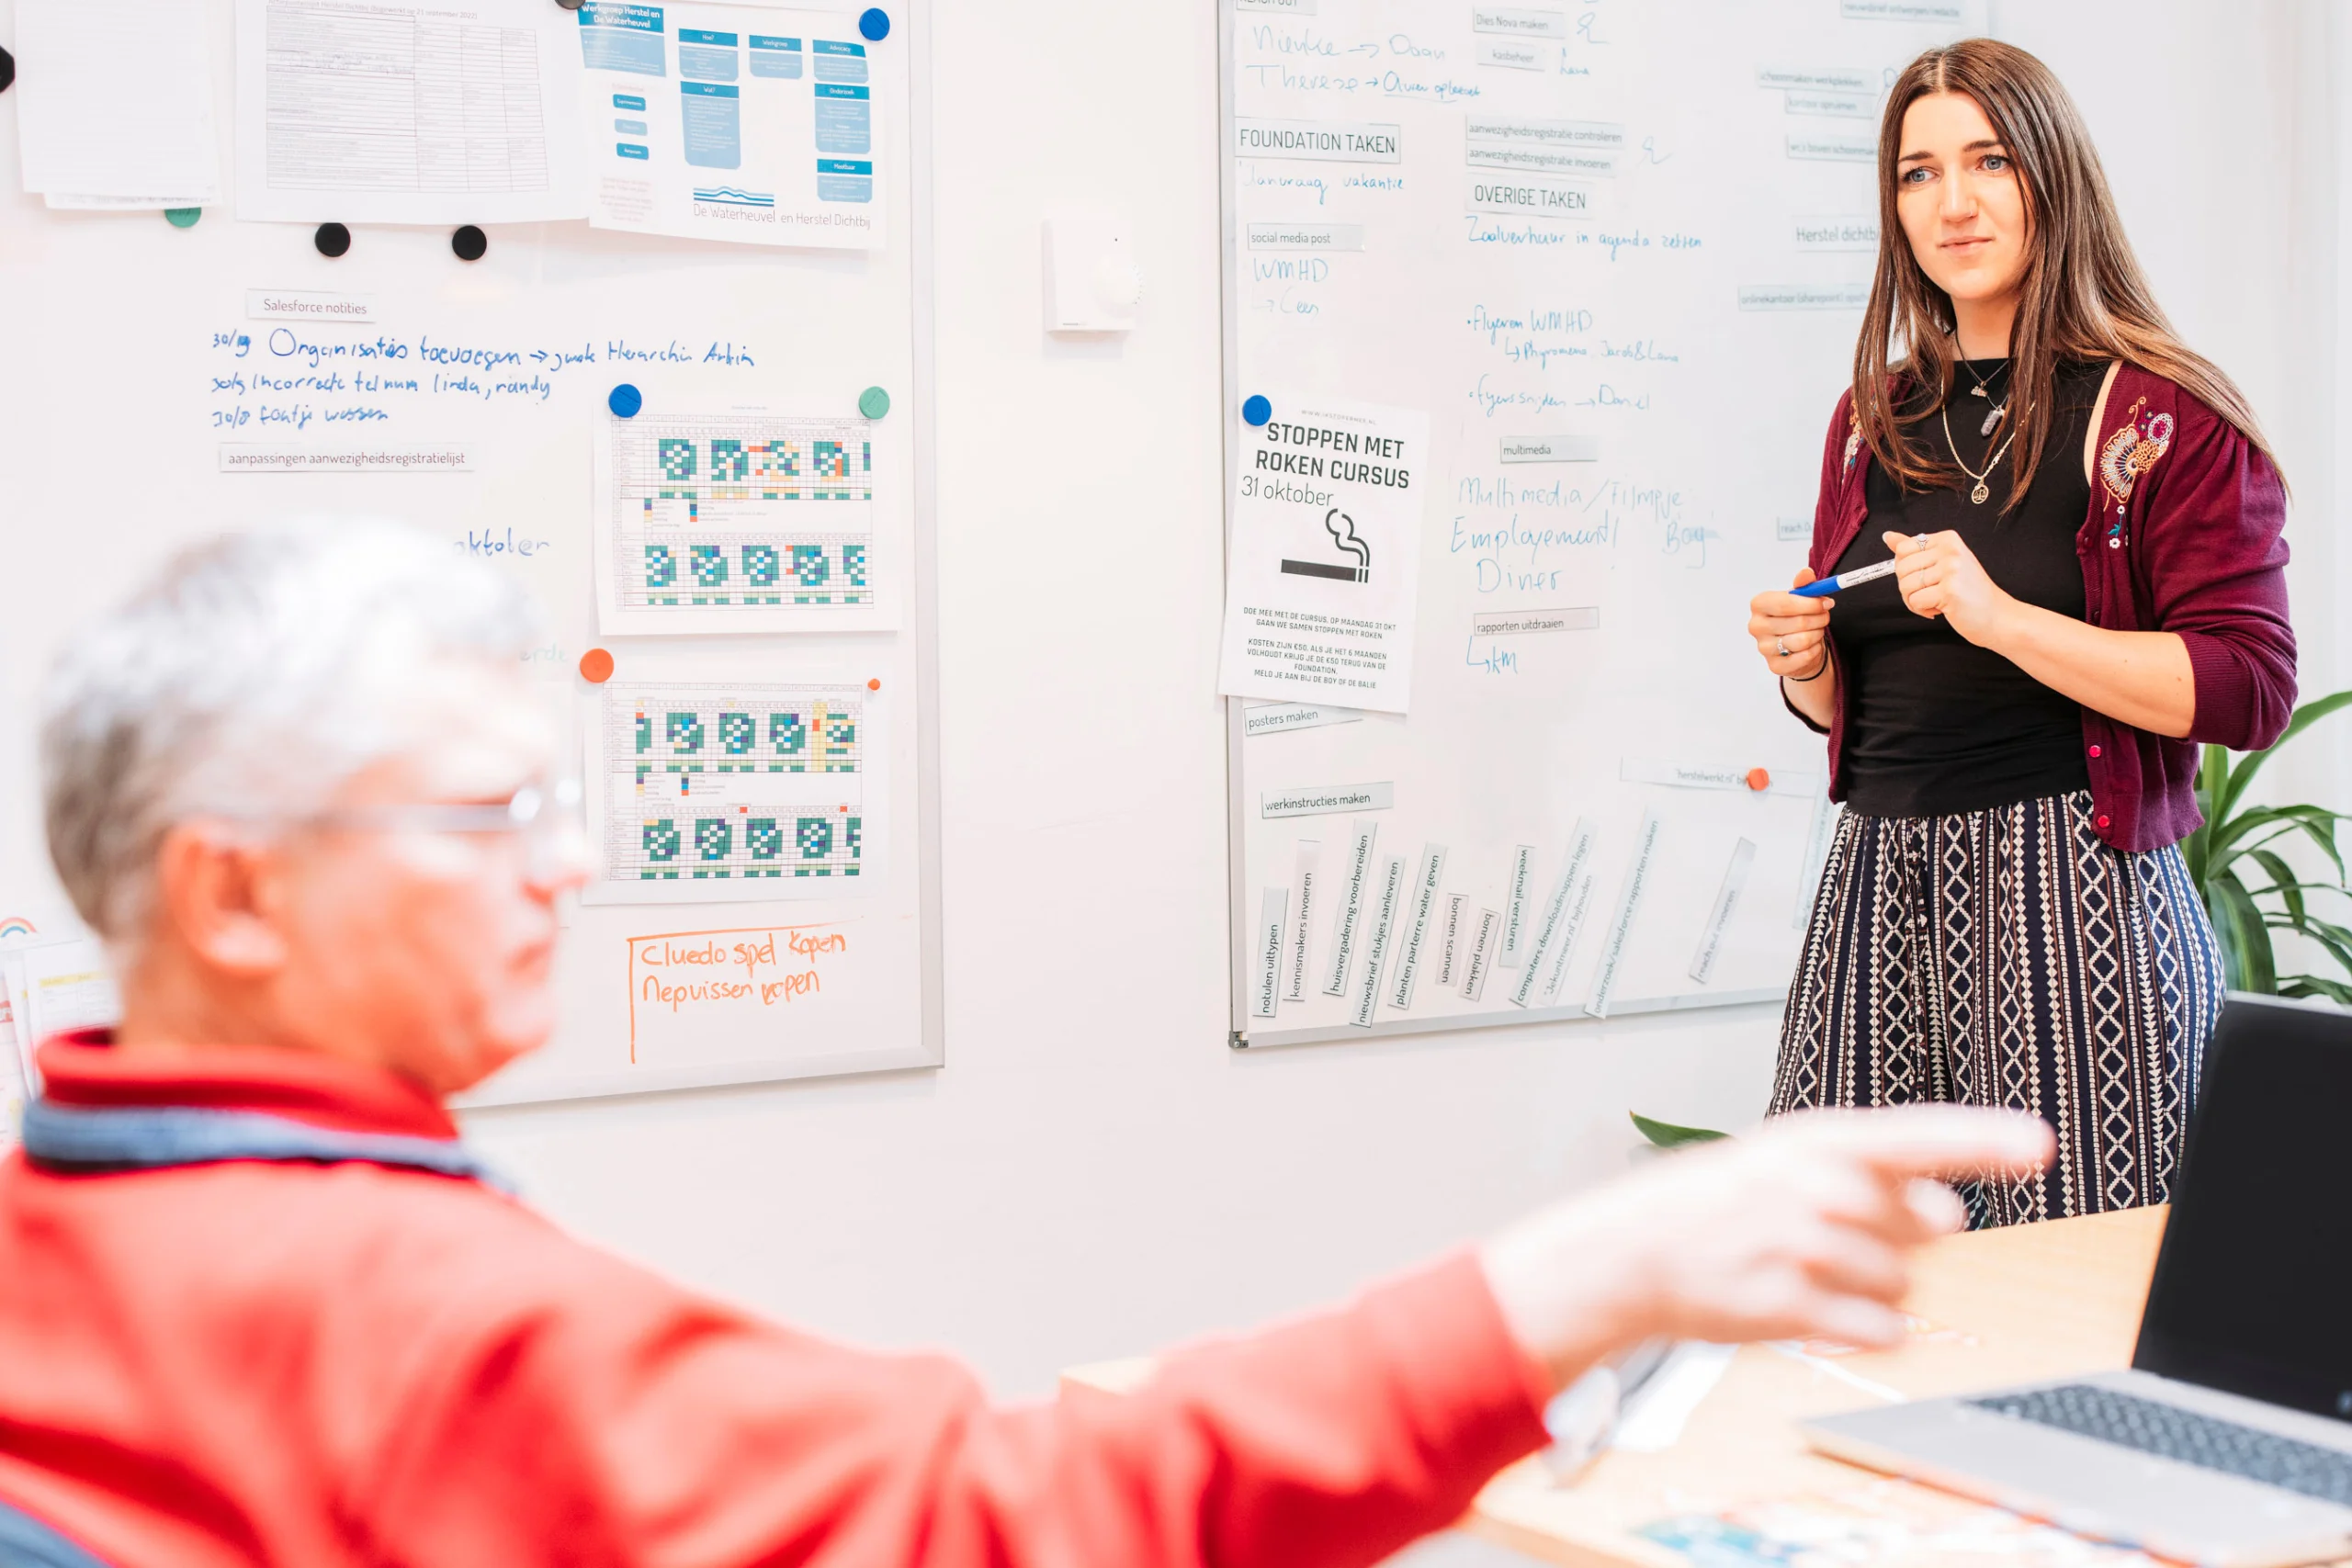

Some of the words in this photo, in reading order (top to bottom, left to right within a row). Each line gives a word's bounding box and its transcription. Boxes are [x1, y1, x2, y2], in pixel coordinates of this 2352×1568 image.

[582, 4, 623, 16] Werkgroep
[624, 7, 650, 17] Herstel
[605, 16, 650, 28] Waterheuvel
[1496, 17, 1518, 28] Nova
[1520, 18, 1549, 30] maken
[1492, 49, 1535, 63] kasbeheer
[1240, 129, 1341, 151] FOUNDATION
[1346, 134, 1396, 153] TAKEN
[1469, 124, 1573, 141] aanwezigheidsregistratie
[1574, 130, 1623, 142] controleren
[1469, 149, 1573, 166] aanwezigheidsregistratie
[1575, 158, 1611, 170] invoeren
[1342, 173, 1404, 190] vakantie
[1475, 185, 1536, 206] OVERIGE
[1540, 189, 1586, 209] TAKEN
[694, 204, 707, 217] De
[710, 205, 775, 223] Waterheuvel
[781, 215, 794, 223] en
[796, 213, 831, 226] Herstel
[834, 214, 871, 231] Dichtbij
[1251, 232, 1277, 243] social
[1280, 231, 1309, 243] media
[1311, 233, 1331, 246] post
[1577, 230, 1589, 243] in
[1796, 226, 1839, 243] Herstel
[264, 299, 322, 313] Salesforce
[325, 301, 368, 315] notities
[1267, 422, 1359, 453] STOPPEN
[1364, 435, 1405, 459] MET
[1503, 444, 1552, 457] multimedia
[229, 453, 306, 467] aanpassingen
[310, 452, 466, 467] aanwezigheidsregistratielijst
[1256, 449, 1324, 478] ROKEN
[1330, 460, 1410, 489] CURSUS
[1241, 475, 1260, 497] 31
[1263, 479, 1334, 506] oktober
[1243, 606, 1257, 615] DOE
[1259, 609, 1273, 617] MEE
[1274, 611, 1289, 619] MET
[1290, 612, 1298, 620] DE
[1329, 616, 1340, 625] OP
[1340, 618, 1374, 629] MAANDAG
[1374, 622, 1382, 630] 31
[1383, 623, 1396, 632] OKT
[1256, 618, 1275, 627] GAAN
[1276, 621, 1287, 629] WE
[1289, 622, 1313, 632] SAMEN
[1314, 626, 1344, 636] STOPPEN
[1345, 628, 1359, 637] MET
[1360, 630, 1383, 639] ROKEN
[1477, 621, 1520, 636] rapporten
[1521, 618, 1564, 631] uitdraaien
[1247, 648, 1283, 659] VOLHOUDT
[1283, 652, 1305, 661] KRIJG
[1306, 654, 1315, 662] JE
[1326, 657, 1340, 665] €50
[1340, 658, 1362, 667] TERUG
[1363, 660, 1376, 669] VAN
[1377, 662, 1386, 671] DE
[1248, 637, 1275, 648] KOSTEN
[1276, 641, 1293, 649] ZIJN
[1310, 645, 1324, 653] ALS
[1334, 648, 1347, 656] HET
[1354, 649, 1387, 660] MAANDEN
[1254, 669, 1273, 678] MELD
[1284, 672, 1299, 681] AAN
[1313, 675, 1322, 683] DE
[1323, 677, 1337, 685] BOY
[1358, 681, 1376, 689] BALIE
[1249, 714, 1283, 730] posters
[1286, 709, 1318, 724] maken
[1265, 796, 1338, 811] werkinstructies
[1339, 793, 1371, 805] maken
[1516, 850, 1528, 898] weekmail
[1628, 856, 1647, 905] rapporten
[1644, 820, 1658, 855] maken
[1330, 906, 1358, 992] huisvergadering
[1350, 835, 1368, 905] voorbereiden
[1449, 897, 1462, 937] bonnen
[1507, 899, 1521, 952] versturen
[1518, 949, 1544, 1001] computers
[1538, 863, 1577, 948] downloadmappen
[1574, 834, 1589, 863] legen
[1290, 921, 1307, 998] kennismakers
[1302, 873, 1313, 919] invoeren
[1396, 965, 1412, 1006] planten
[1408, 919, 1424, 964] parterre
[1419, 888, 1430, 919] water
[1427, 854, 1440, 887] geven
[1478, 913, 1495, 952] bonnen
[641, 941, 727, 966] Cluedo
[733, 931, 776, 978] spel
[1266, 924, 1279, 969] uittypen
[1359, 961, 1378, 1023] nieuwsbrief
[1373, 921, 1387, 959] stukjes
[1382, 862, 1399, 920] aanleveren
[1442, 939, 1456, 983] scannen
[1465, 953, 1482, 995] plakken
[1262, 973, 1274, 1013] notulen
